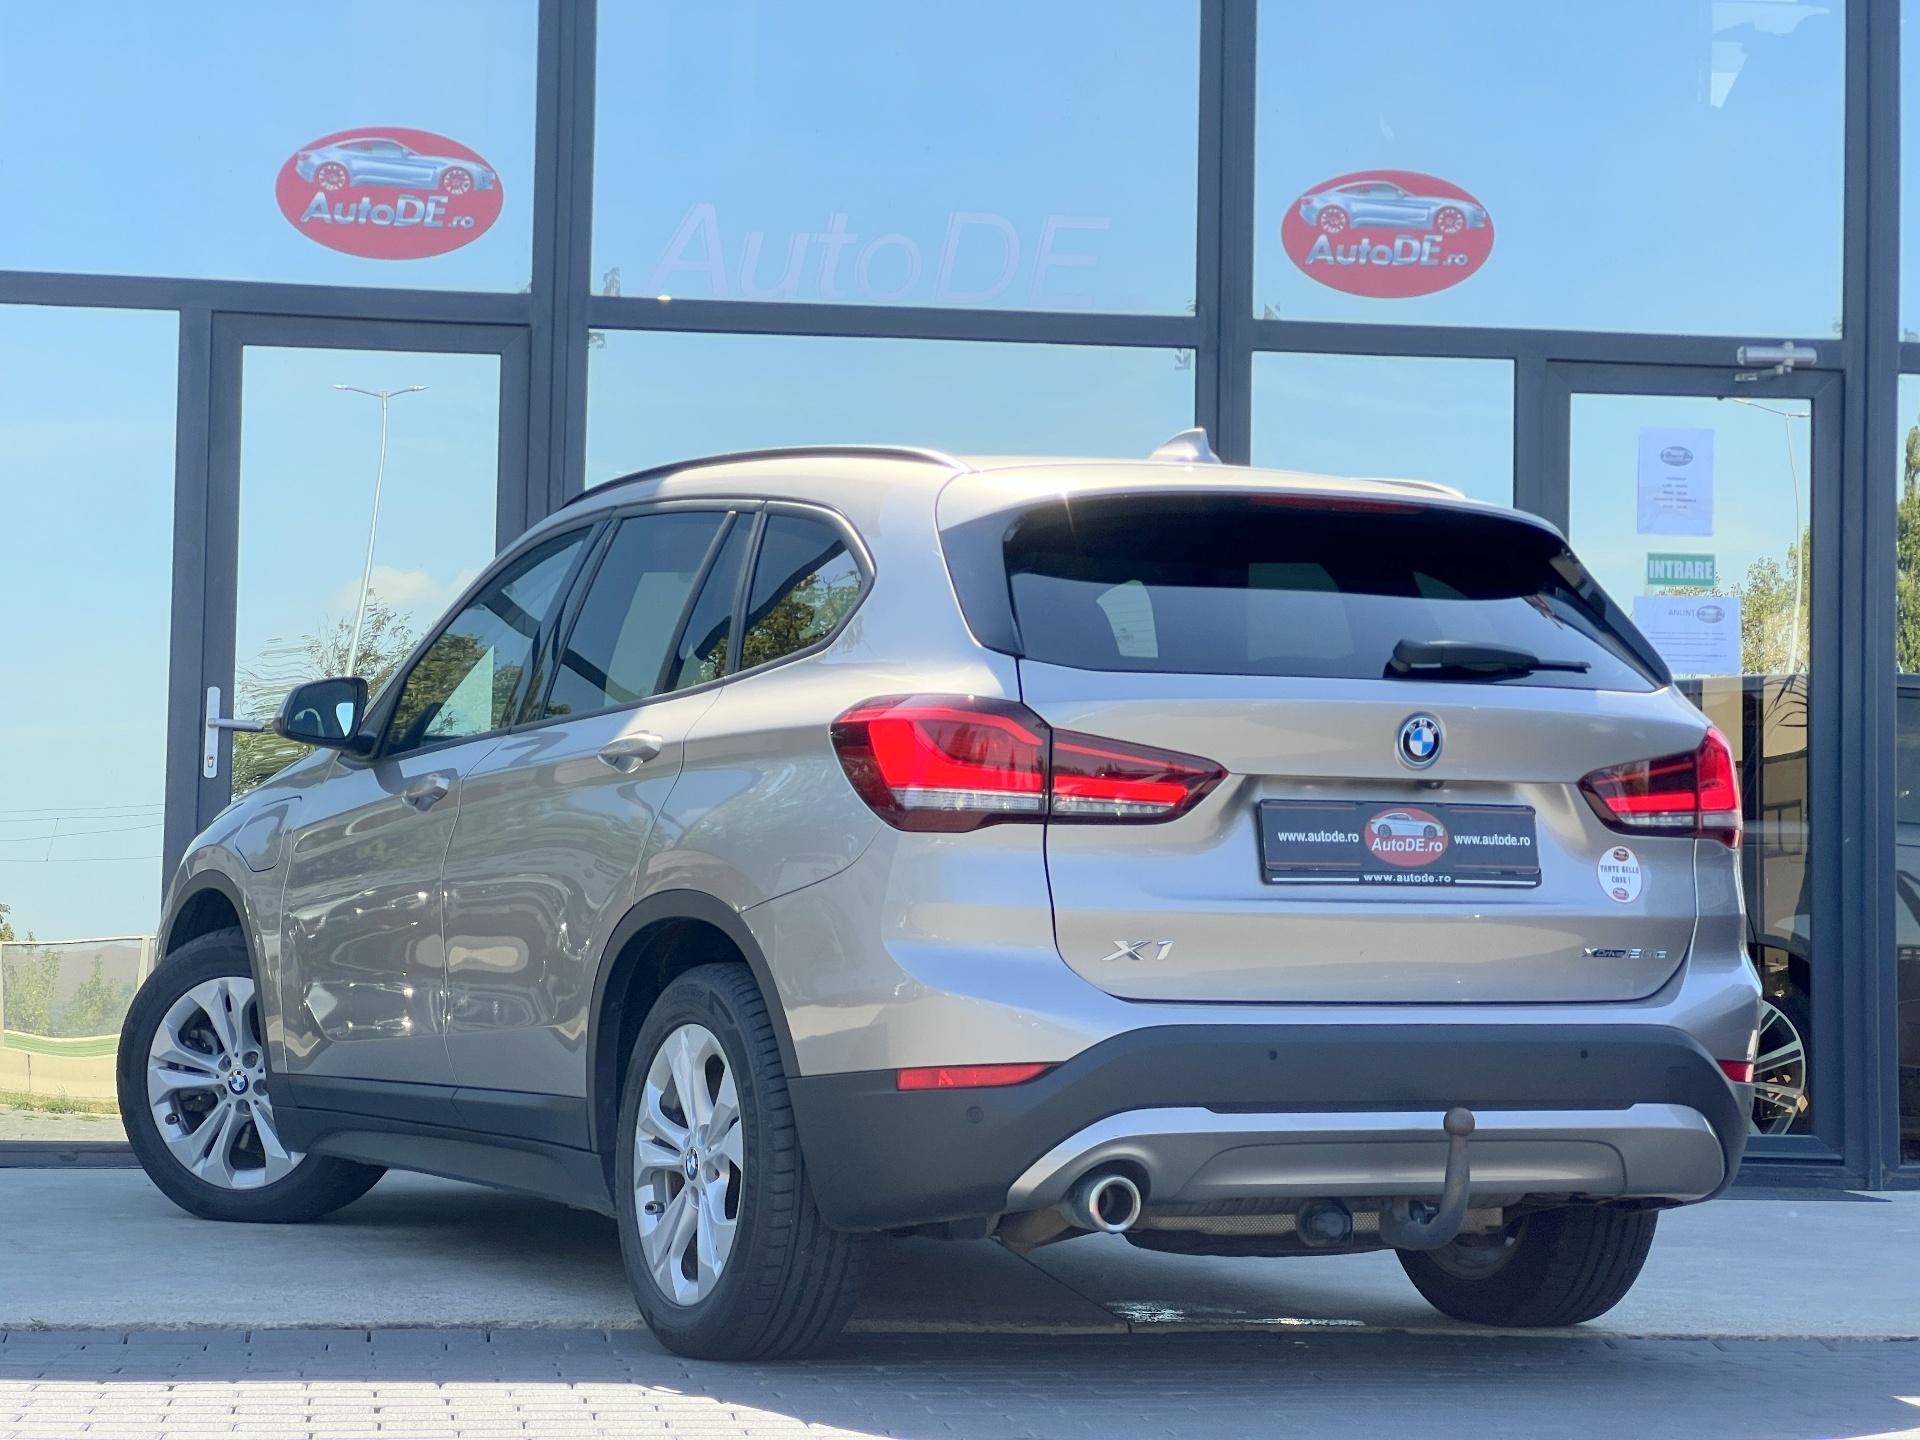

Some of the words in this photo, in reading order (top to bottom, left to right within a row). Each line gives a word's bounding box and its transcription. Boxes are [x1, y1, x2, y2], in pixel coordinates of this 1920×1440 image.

[641, 200, 1112, 308] AutoDE
[1649, 559, 1714, 580] INTRARE
[1278, 830, 1359, 843] www.autode.ro
[1454, 834, 1531, 846] www.autode.ro
[1371, 837, 1444, 853] AutoDE.ro
[1363, 873, 1452, 883] www.autode.ro
[1101, 940, 1175, 961] X1
